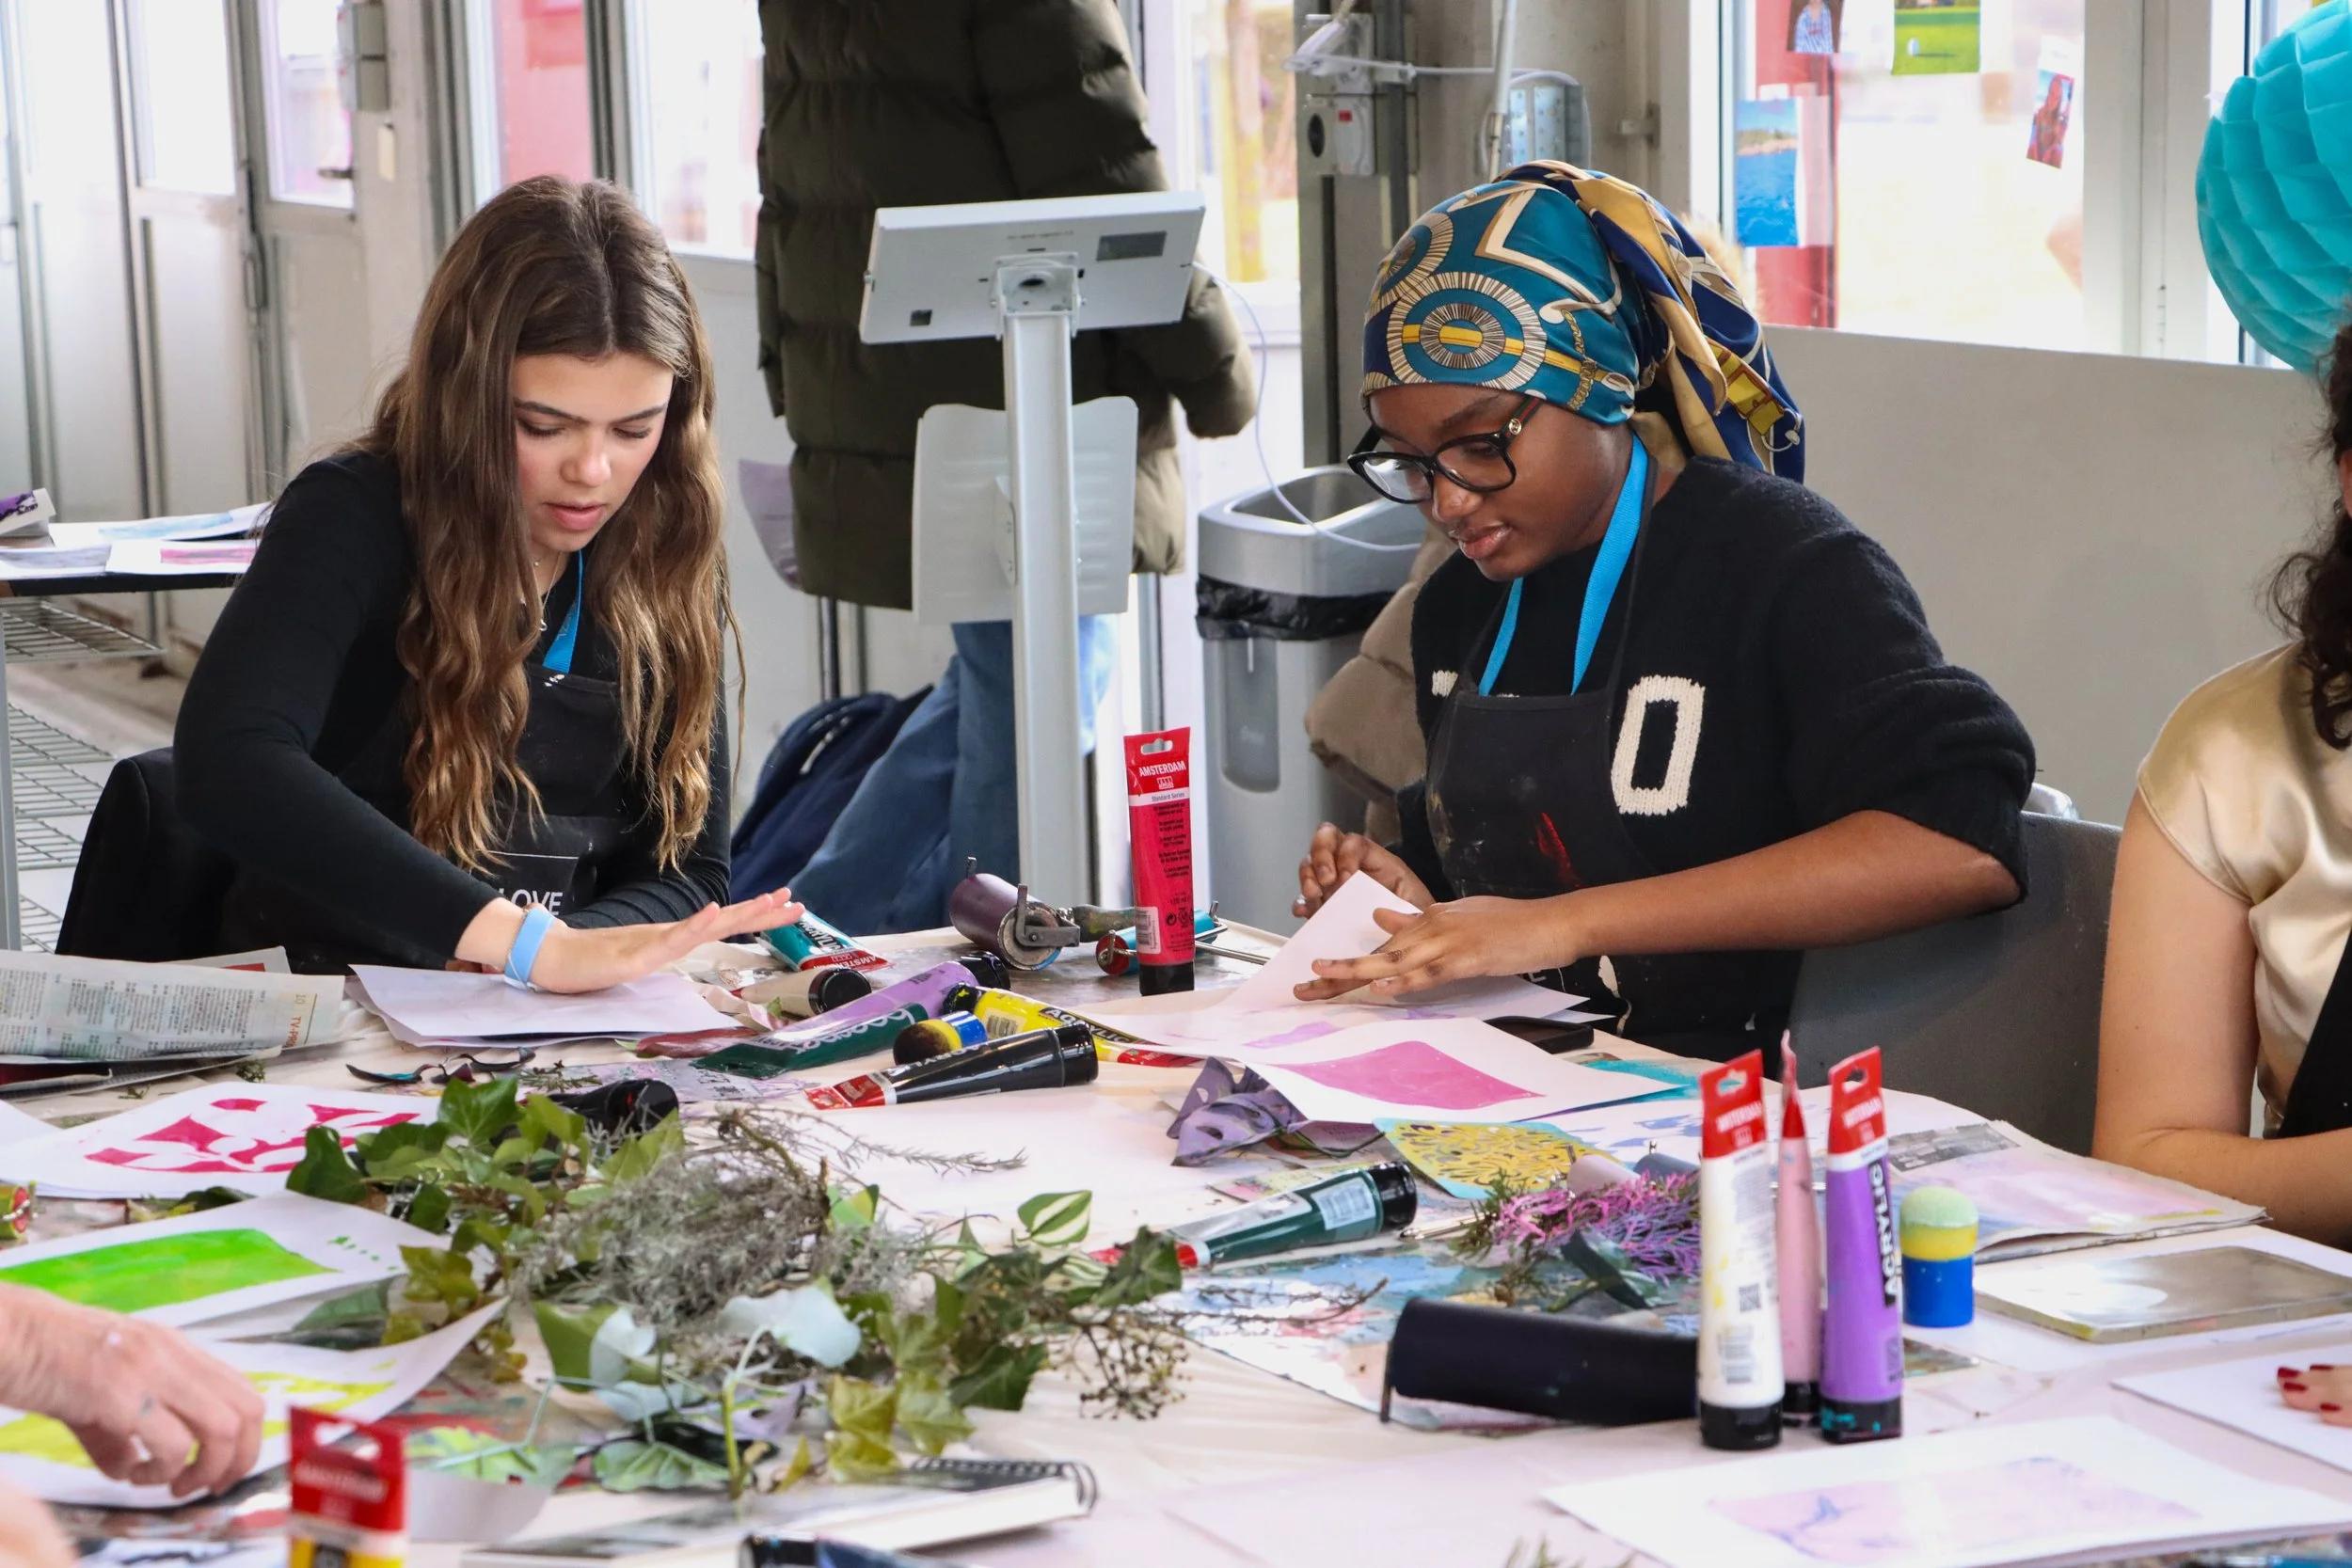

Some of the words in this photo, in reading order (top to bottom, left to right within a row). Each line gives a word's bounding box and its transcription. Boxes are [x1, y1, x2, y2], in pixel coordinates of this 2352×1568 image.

[1139, 760, 1186, 777] AMSTERDAM
[499, 888, 563, 916] OVE
[1869, 1164, 1899, 1296] ACRYLIC
